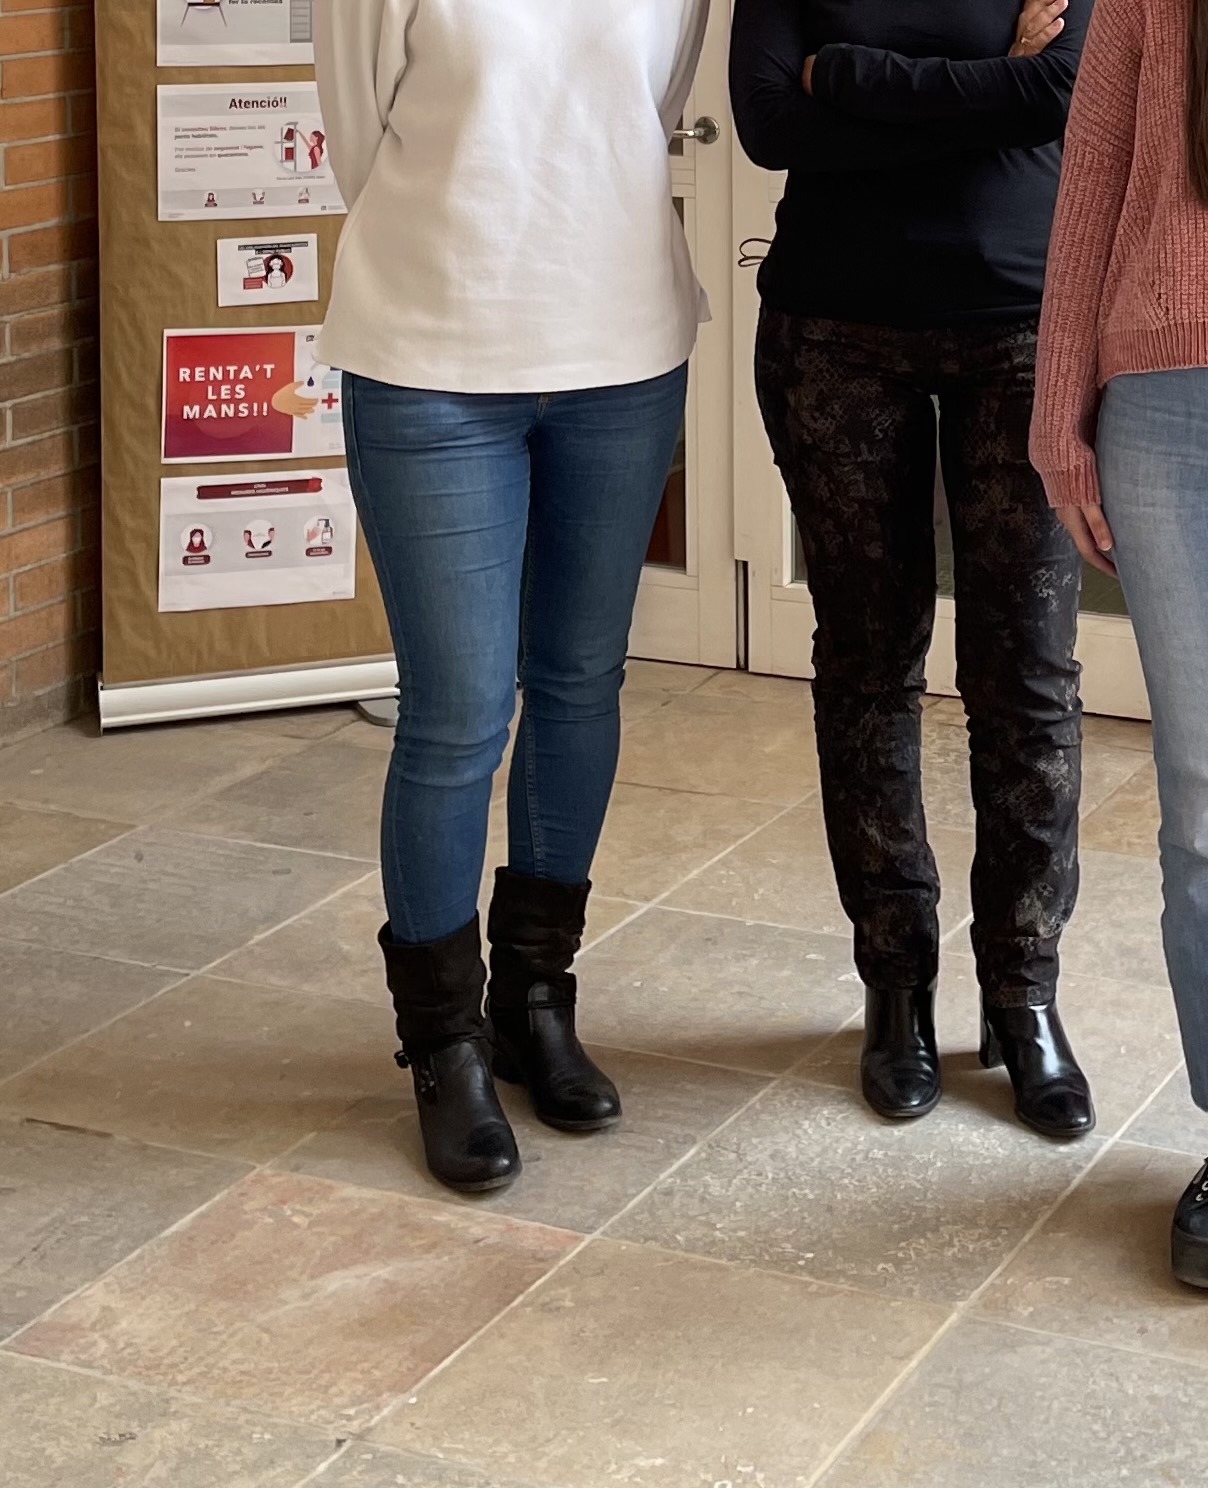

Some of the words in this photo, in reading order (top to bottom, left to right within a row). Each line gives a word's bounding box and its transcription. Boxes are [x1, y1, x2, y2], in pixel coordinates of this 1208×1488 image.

[229, 96, 288, 110] Atenció!!
[207, 384, 246, 400] LES
[182, 401, 269, 420] MANS!!
